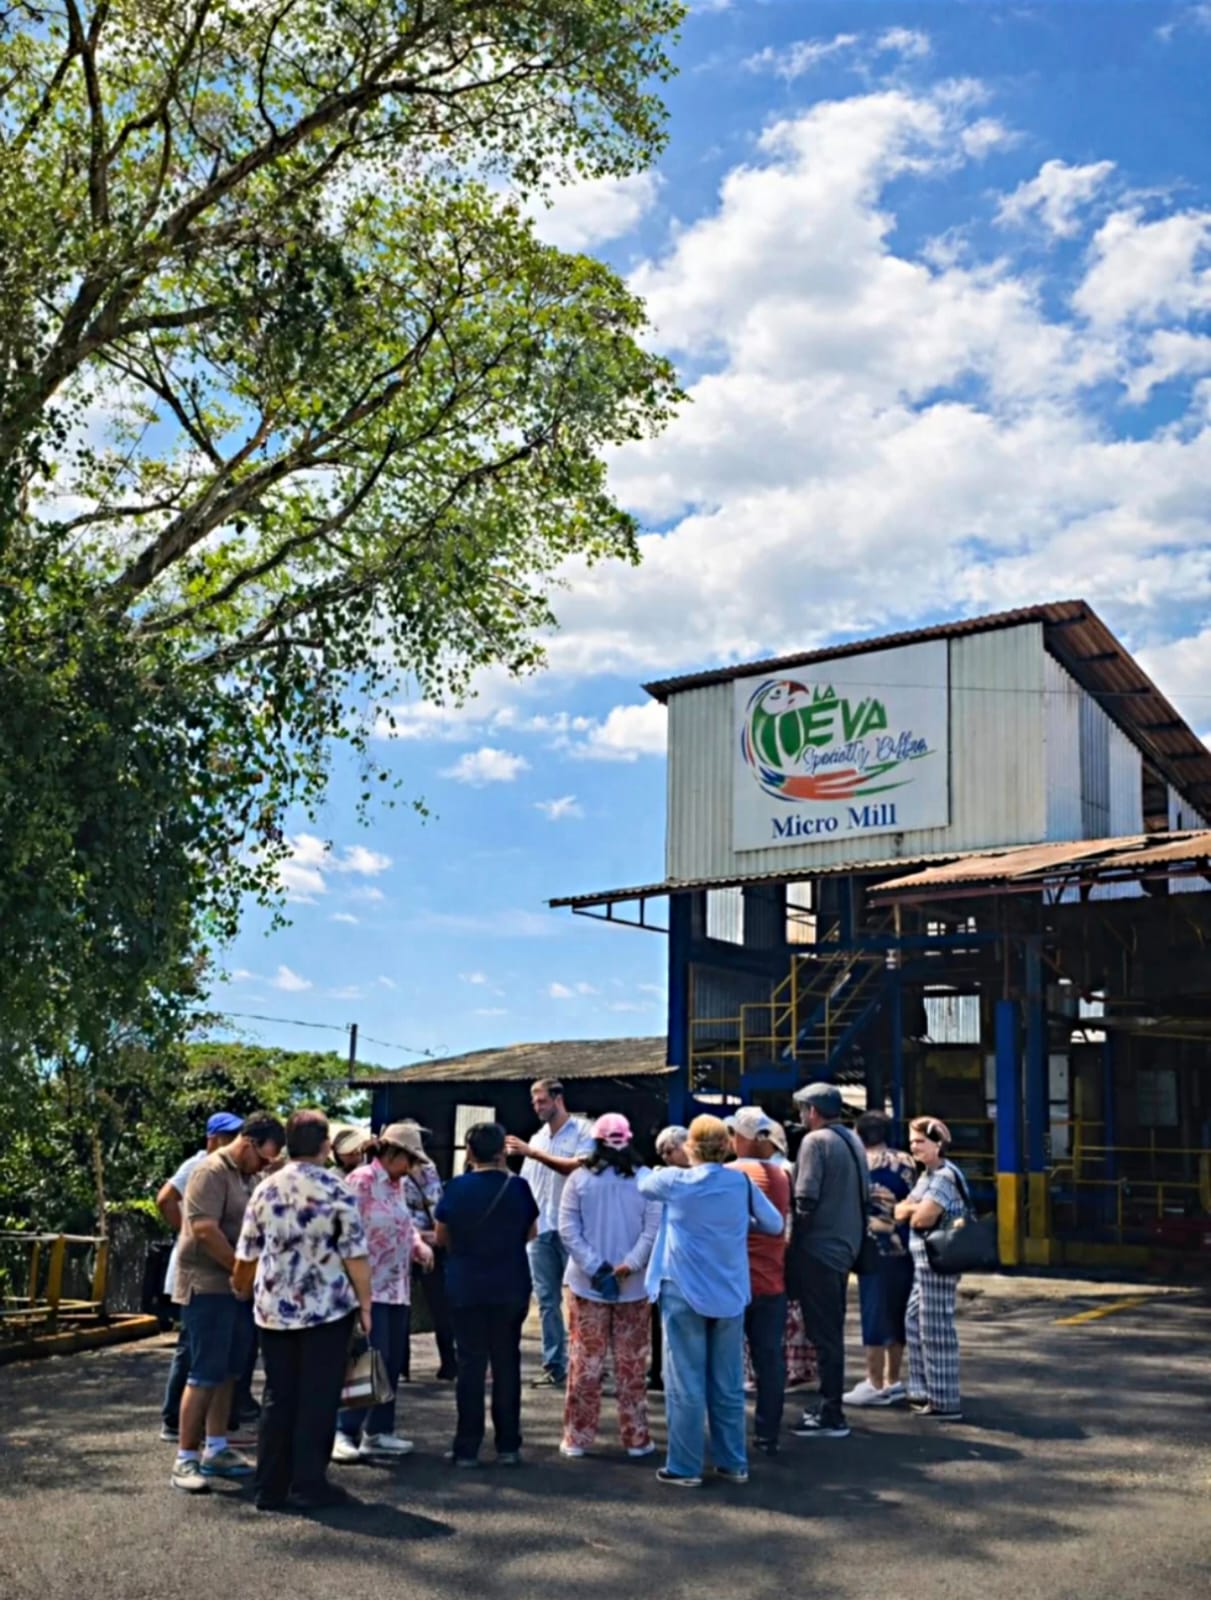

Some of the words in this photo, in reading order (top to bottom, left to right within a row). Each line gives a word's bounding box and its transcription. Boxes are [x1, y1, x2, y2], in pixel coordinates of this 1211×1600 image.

[813, 683, 835, 703] LA
[771, 814, 838, 839] Micro
[847, 803, 898, 830] Mill
